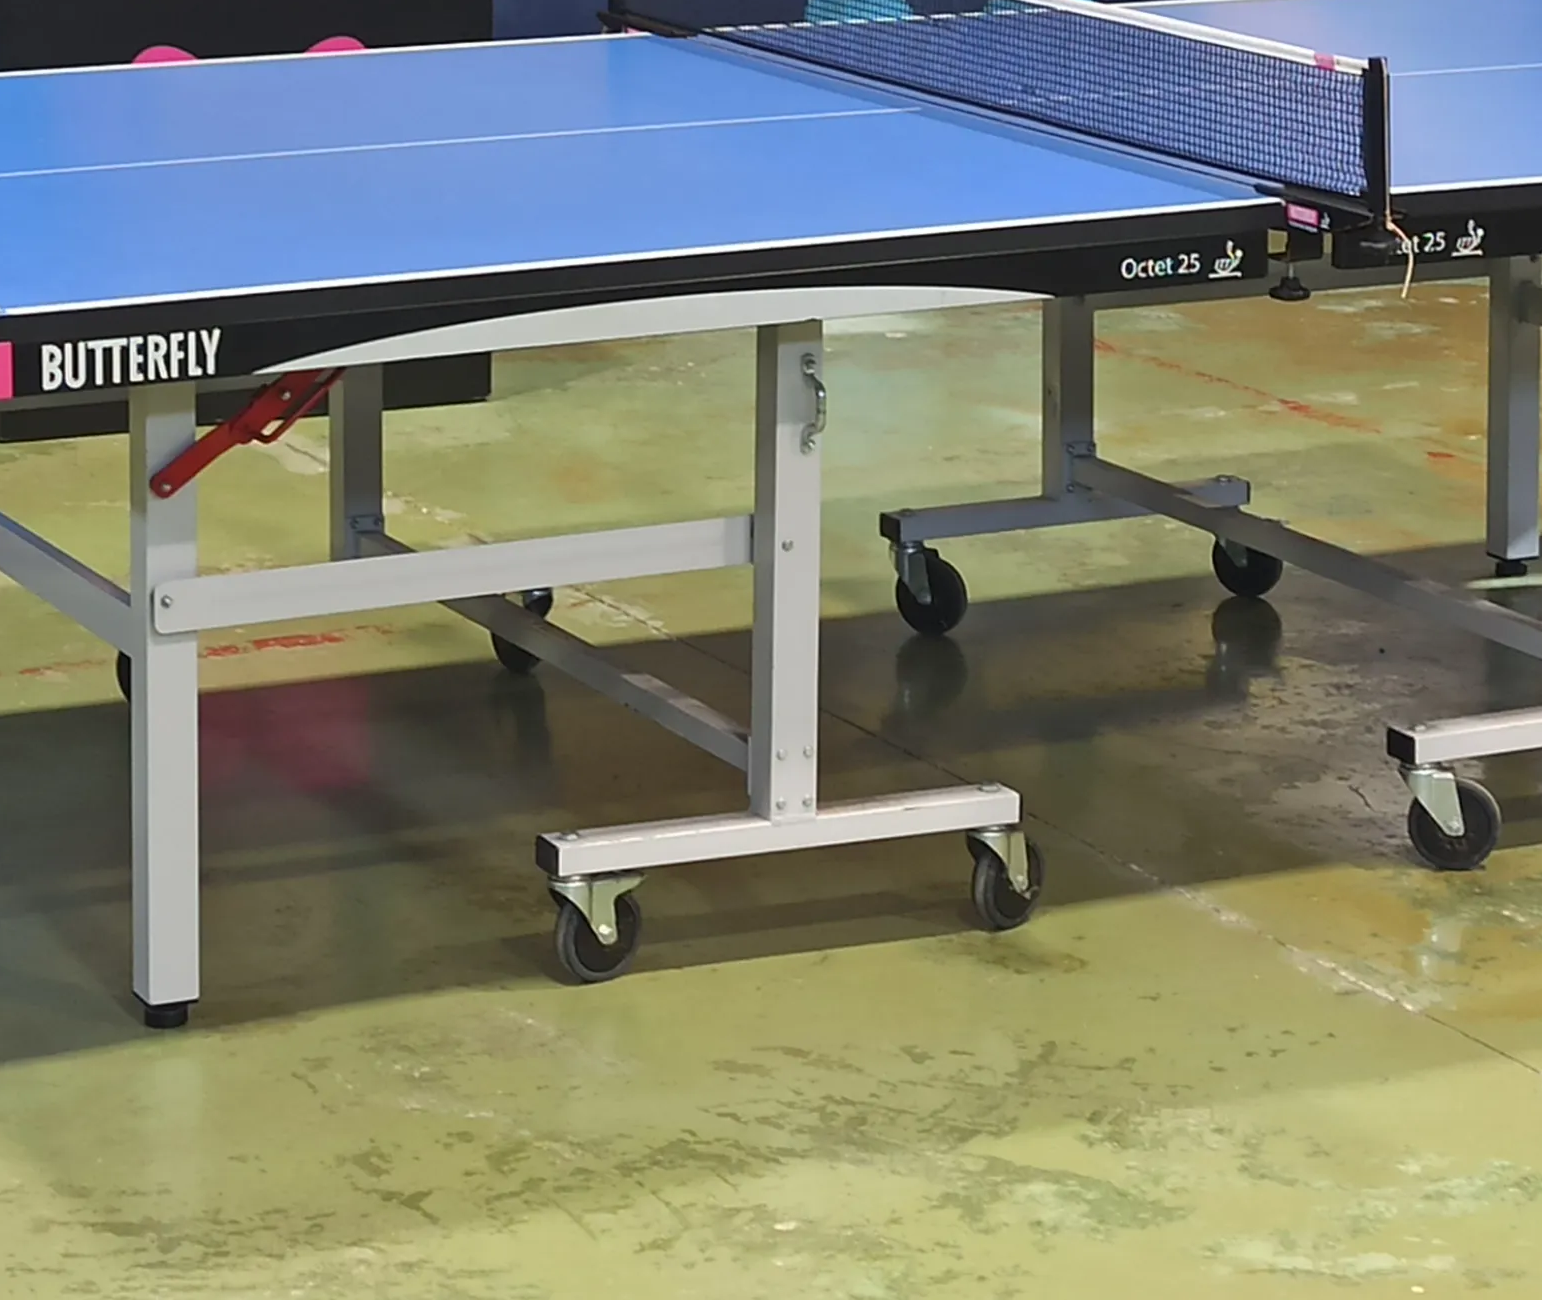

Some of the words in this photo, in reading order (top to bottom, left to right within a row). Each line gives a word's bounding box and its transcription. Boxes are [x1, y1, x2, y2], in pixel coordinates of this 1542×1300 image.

[1423, 231, 1446, 252] 25
[1120, 257, 1174, 279] Octet
[1178, 253, 1201, 274] 25
[41, 327, 222, 391] BUTTERFLY
